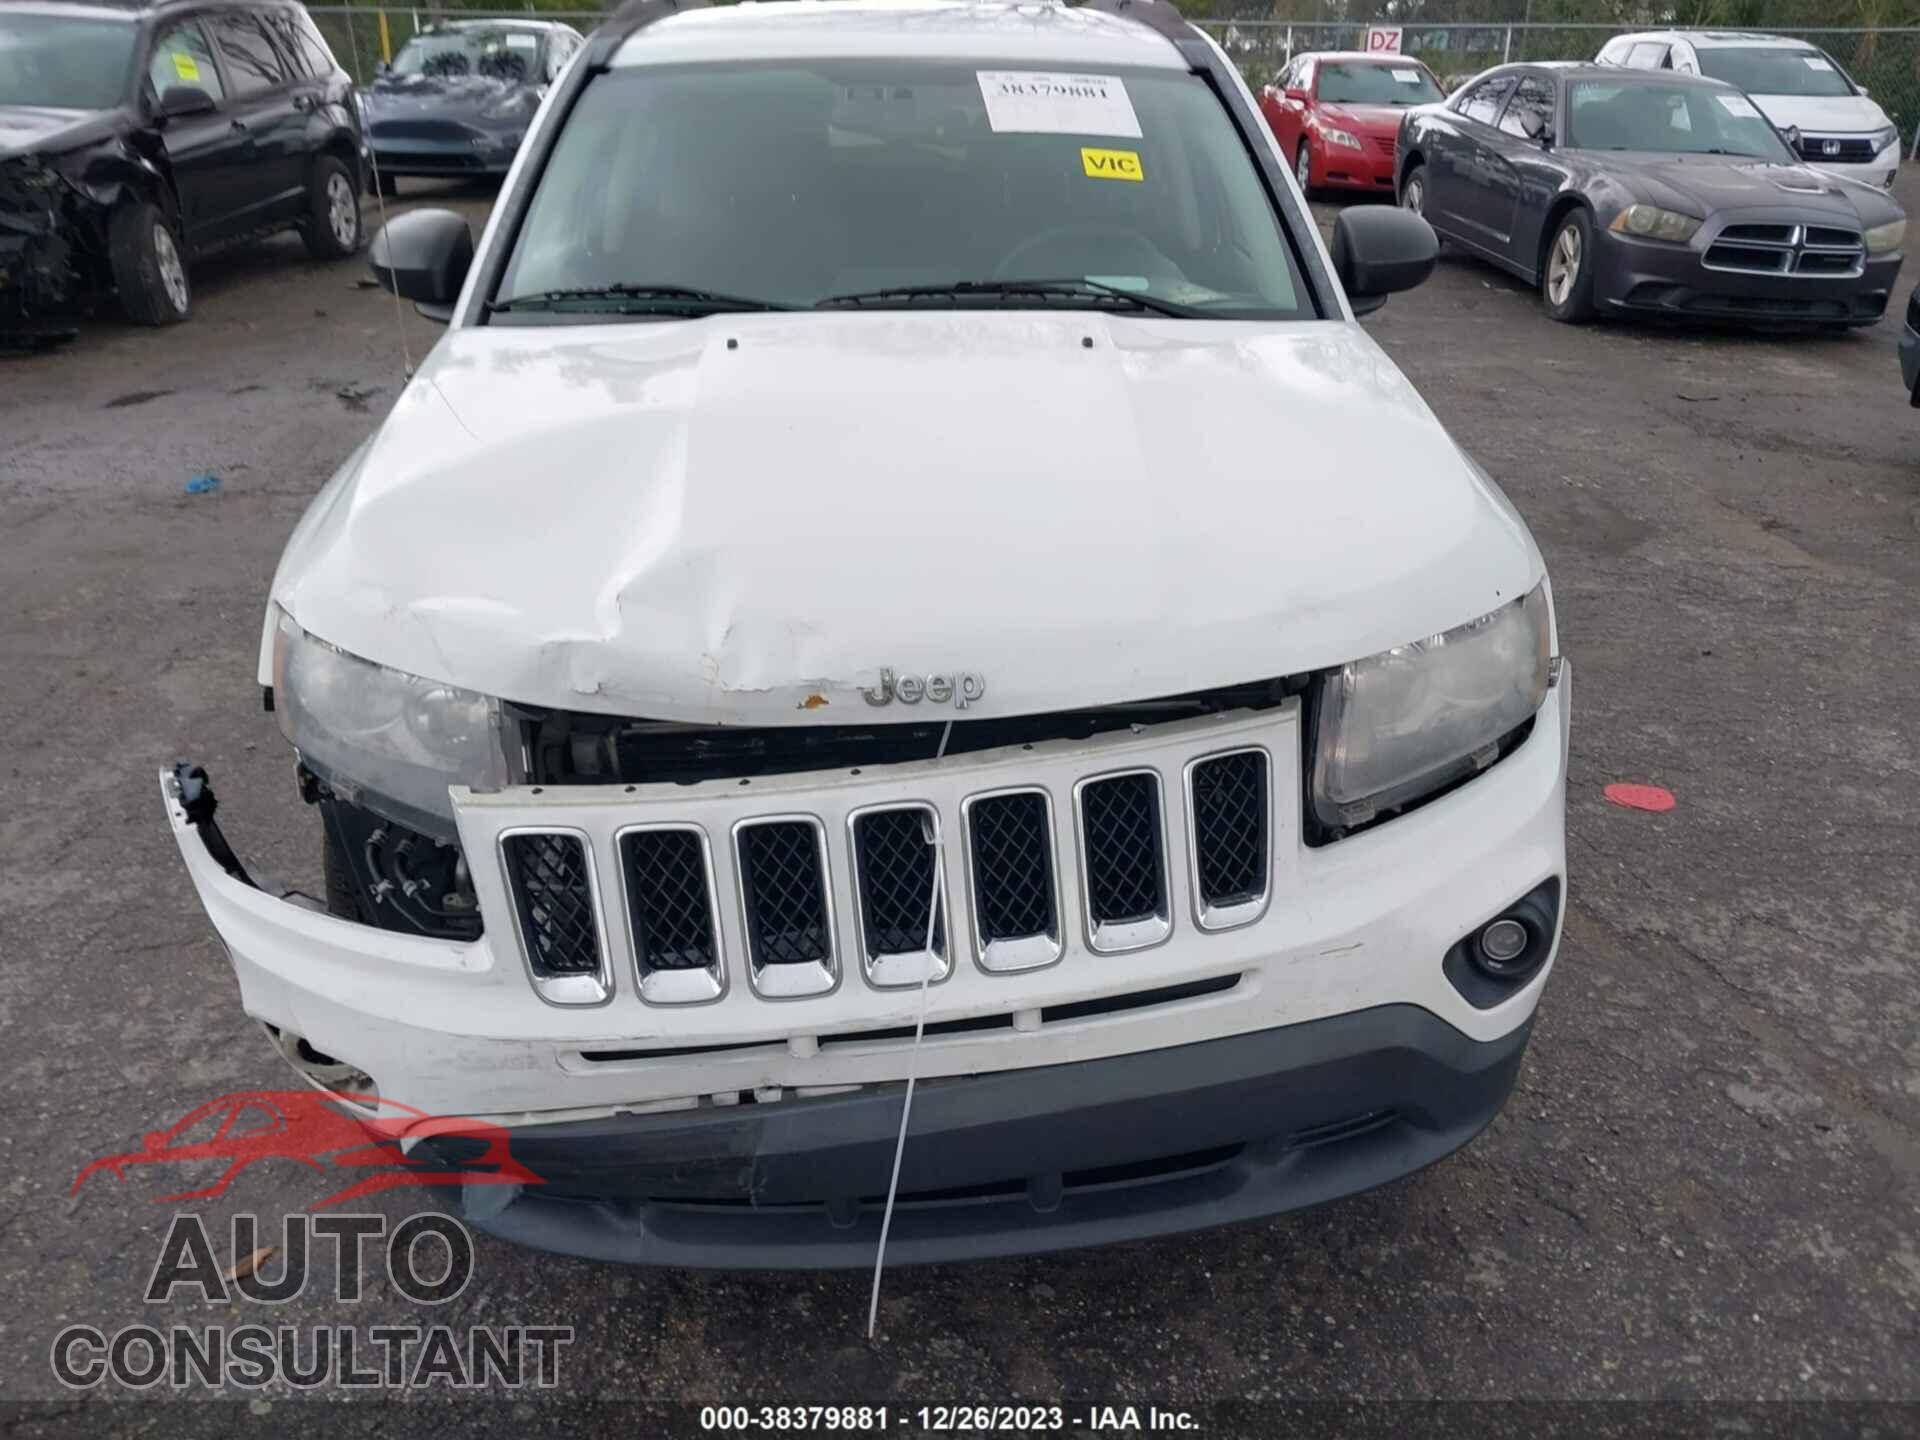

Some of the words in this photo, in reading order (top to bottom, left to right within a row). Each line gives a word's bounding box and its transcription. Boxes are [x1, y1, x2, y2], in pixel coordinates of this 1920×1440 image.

[1371, 31, 1400, 51] DZ
[1087, 155, 1136, 173] VIC
[862, 666, 985, 710] Jeep
